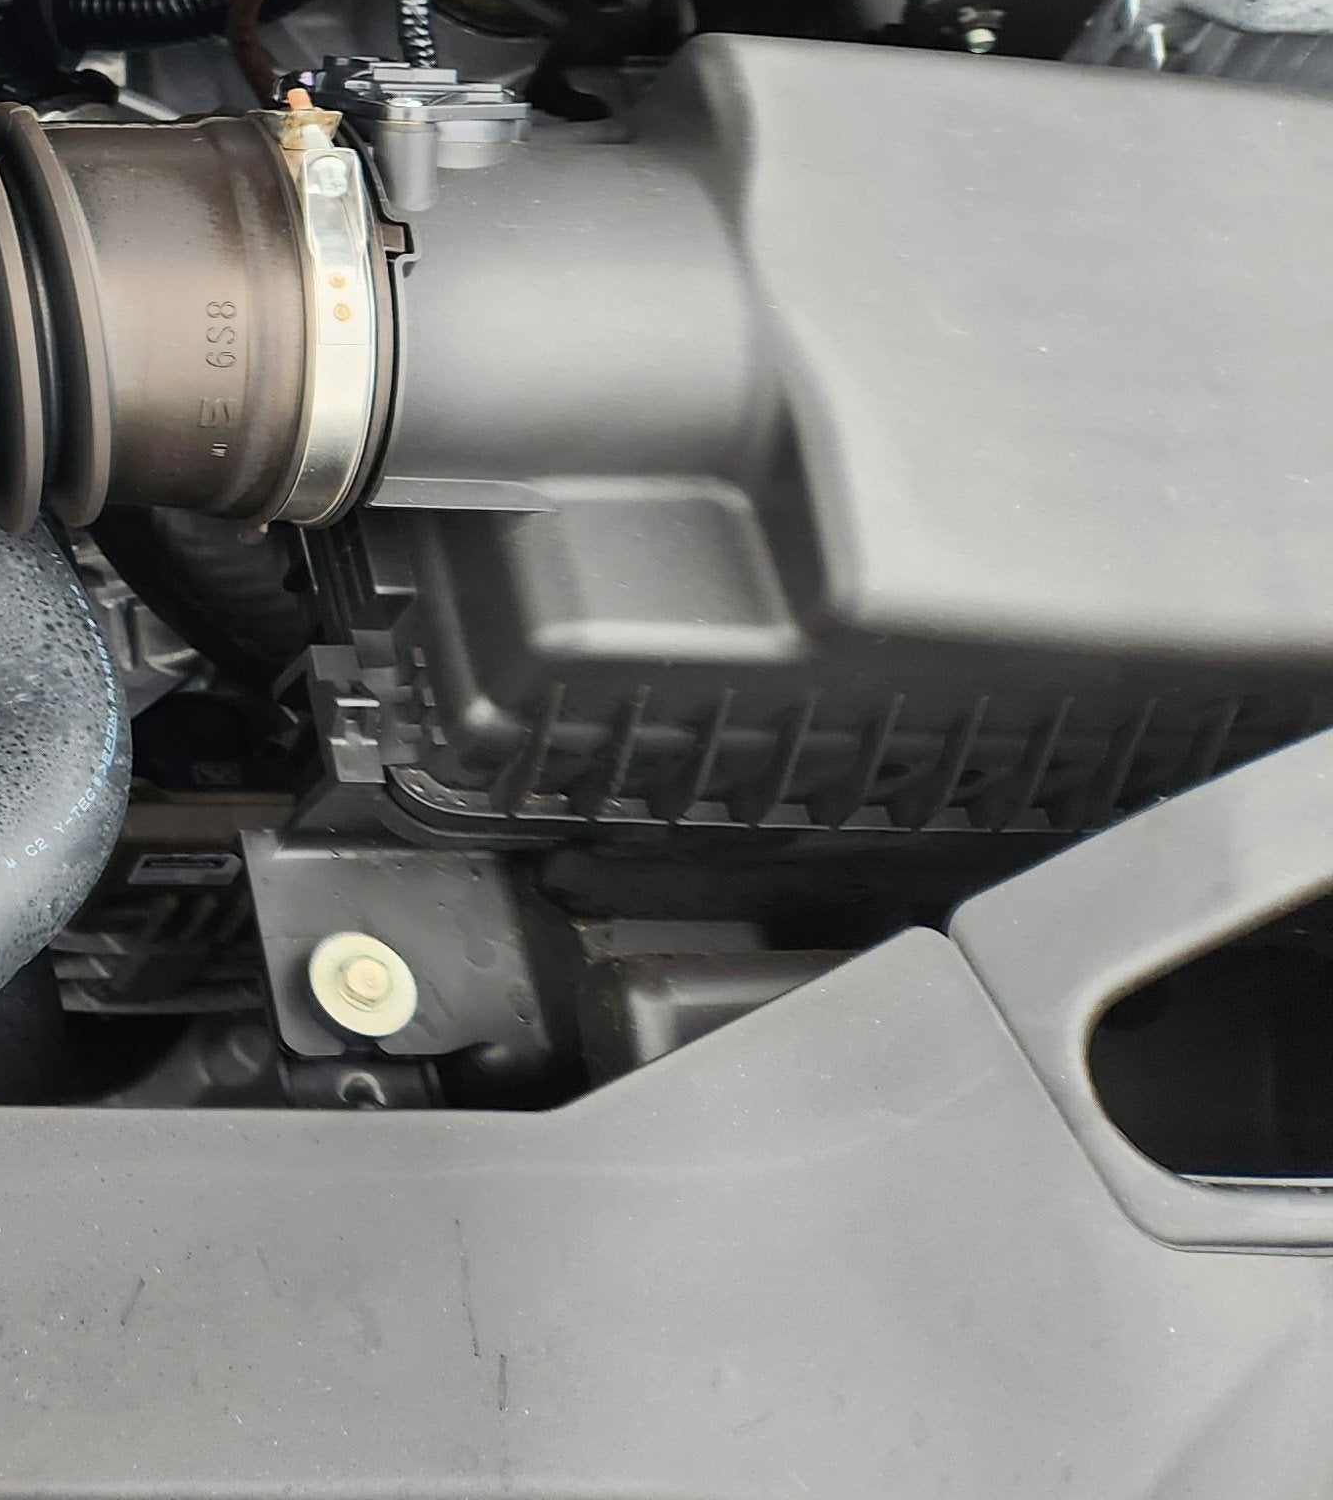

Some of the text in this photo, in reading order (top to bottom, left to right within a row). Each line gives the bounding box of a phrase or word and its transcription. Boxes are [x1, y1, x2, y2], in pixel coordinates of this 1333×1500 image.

[205, 300, 237, 368] 6S8
[24, 836, 49, 857] C2
[53, 787, 97, 834] Y-TEC
